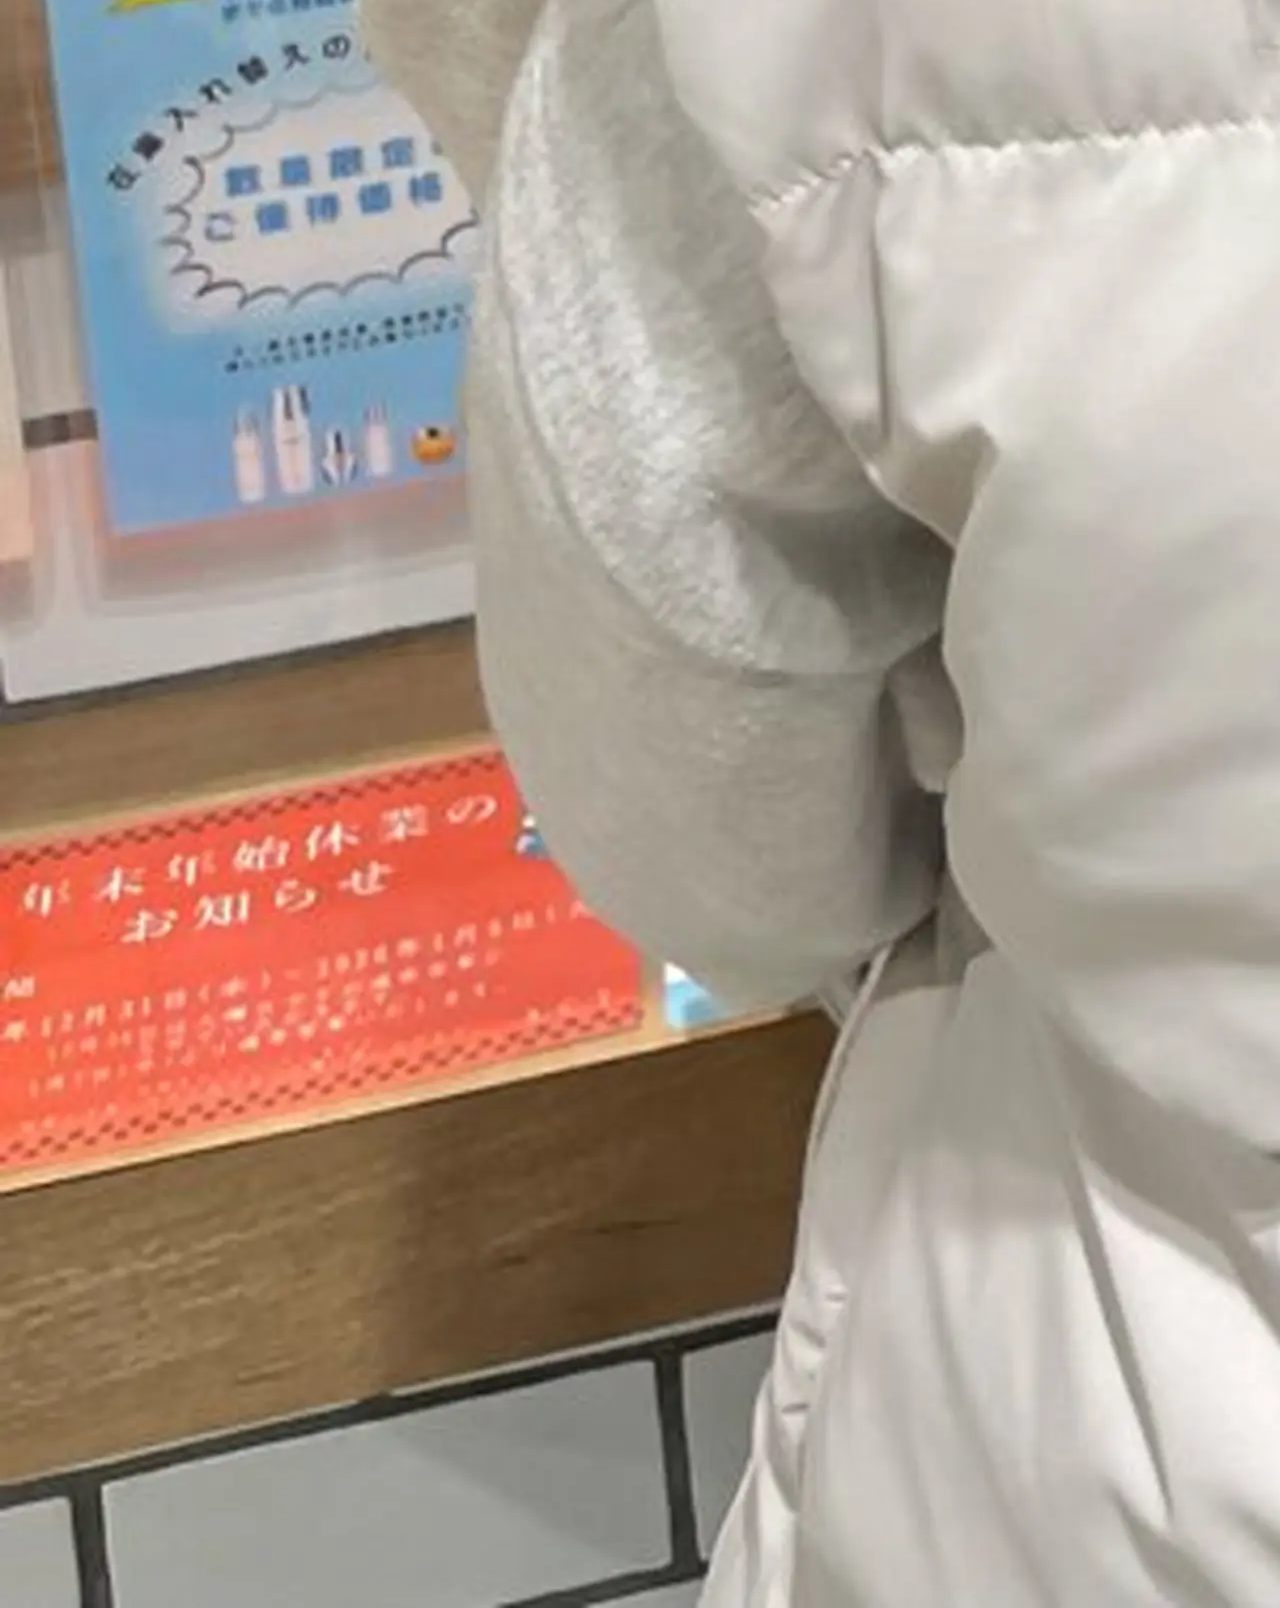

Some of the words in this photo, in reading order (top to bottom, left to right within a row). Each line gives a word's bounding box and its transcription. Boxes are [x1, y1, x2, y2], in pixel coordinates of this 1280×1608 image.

[107, 33, 370, 191] 在庫入れ替えの
[23, 794, 497, 916] 年末年始休業の
[120, 860, 393, 945] お知らせ
